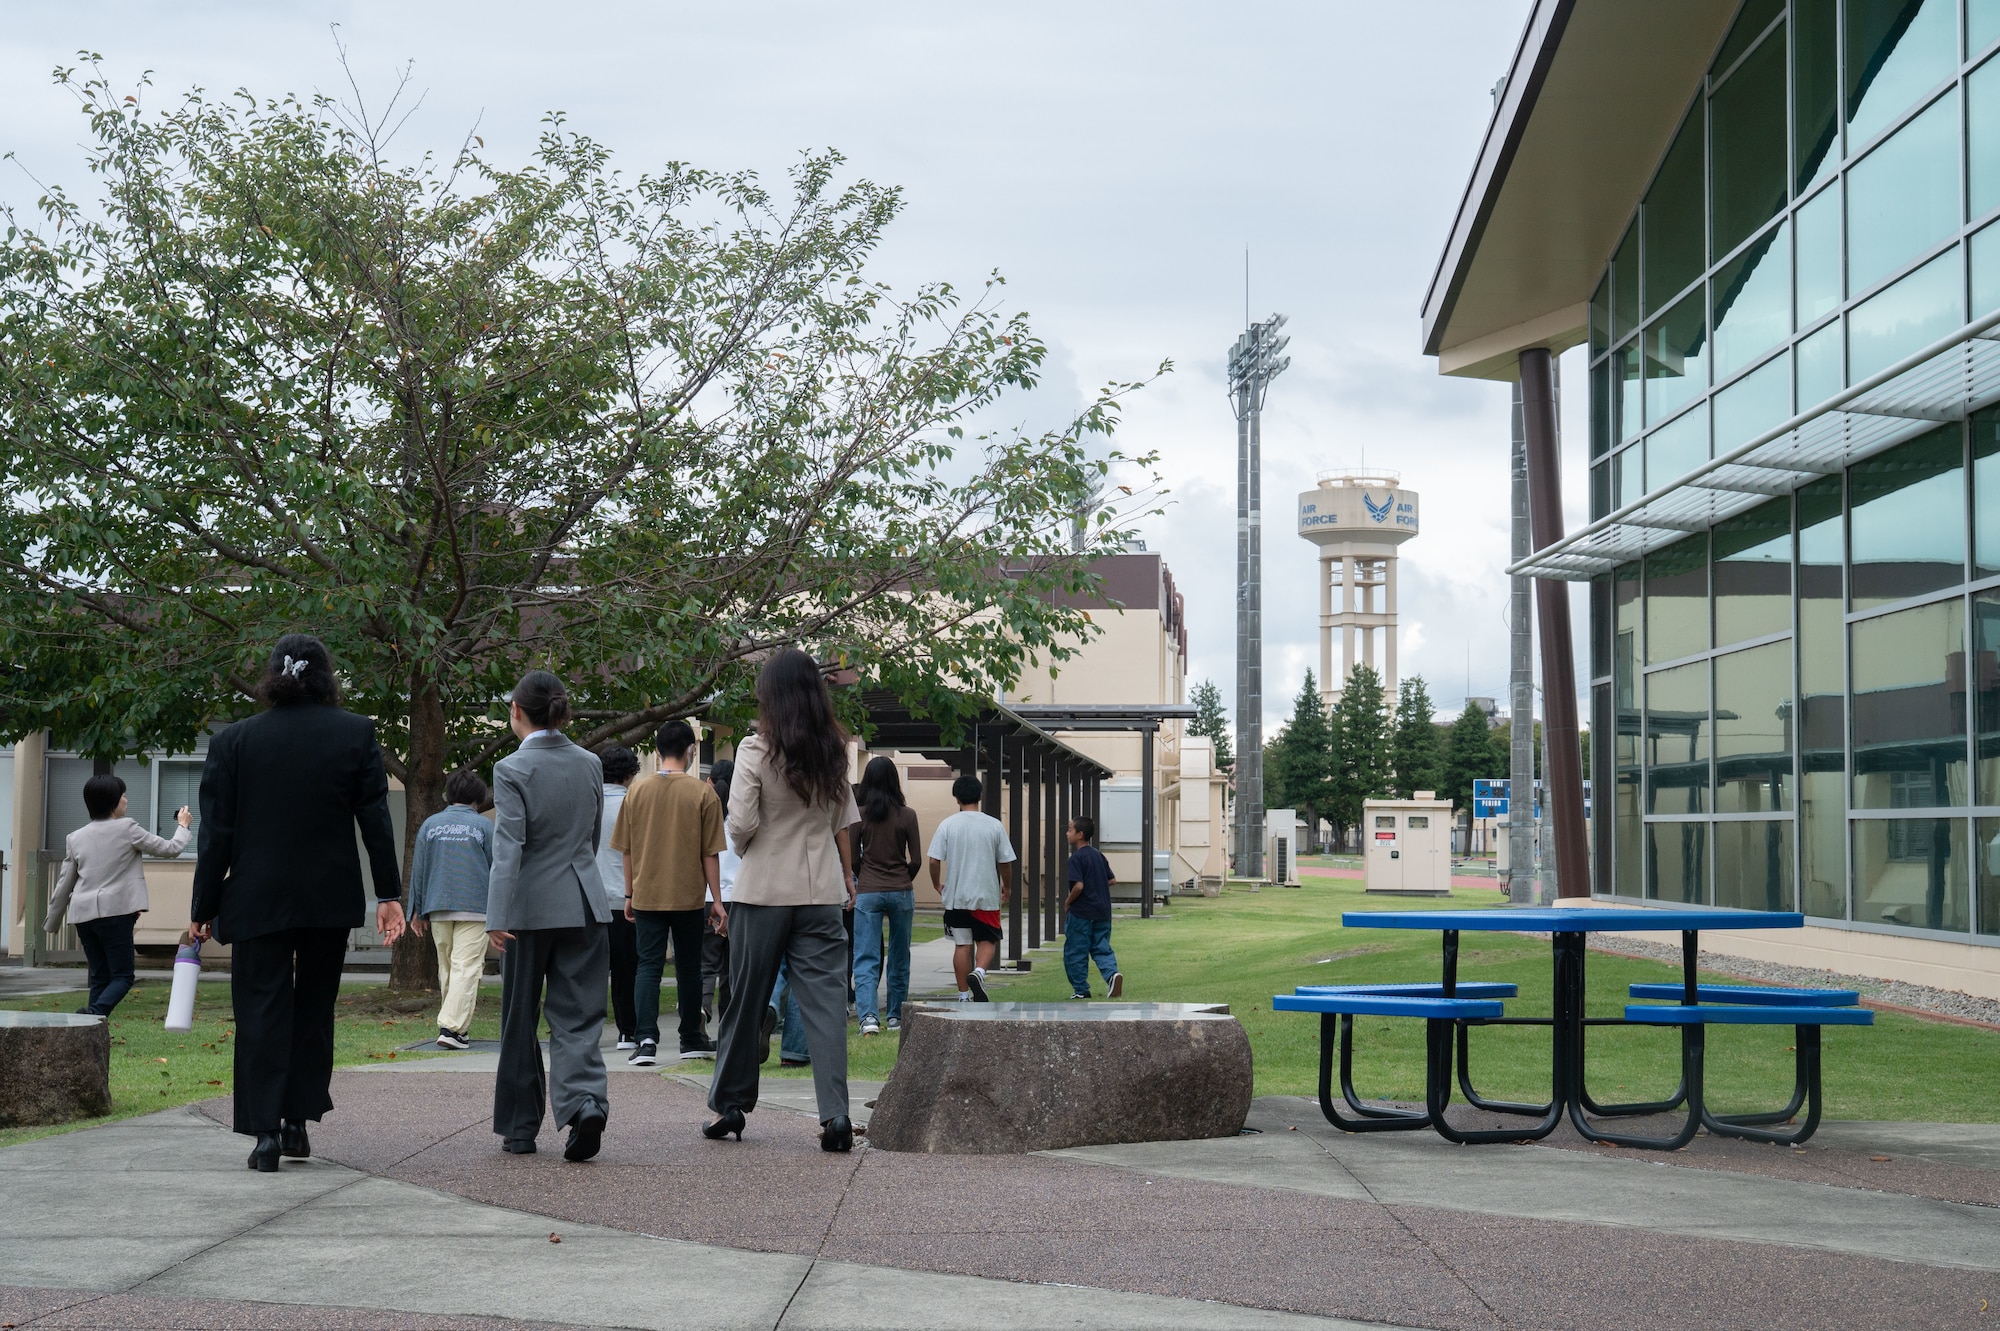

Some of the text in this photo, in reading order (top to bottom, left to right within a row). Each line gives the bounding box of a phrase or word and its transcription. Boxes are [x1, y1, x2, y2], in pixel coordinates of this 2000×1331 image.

[1302, 504, 1316, 515] AIR
[1397, 503, 1413, 513] AIR
[1302, 514, 1338, 527] FORCE
